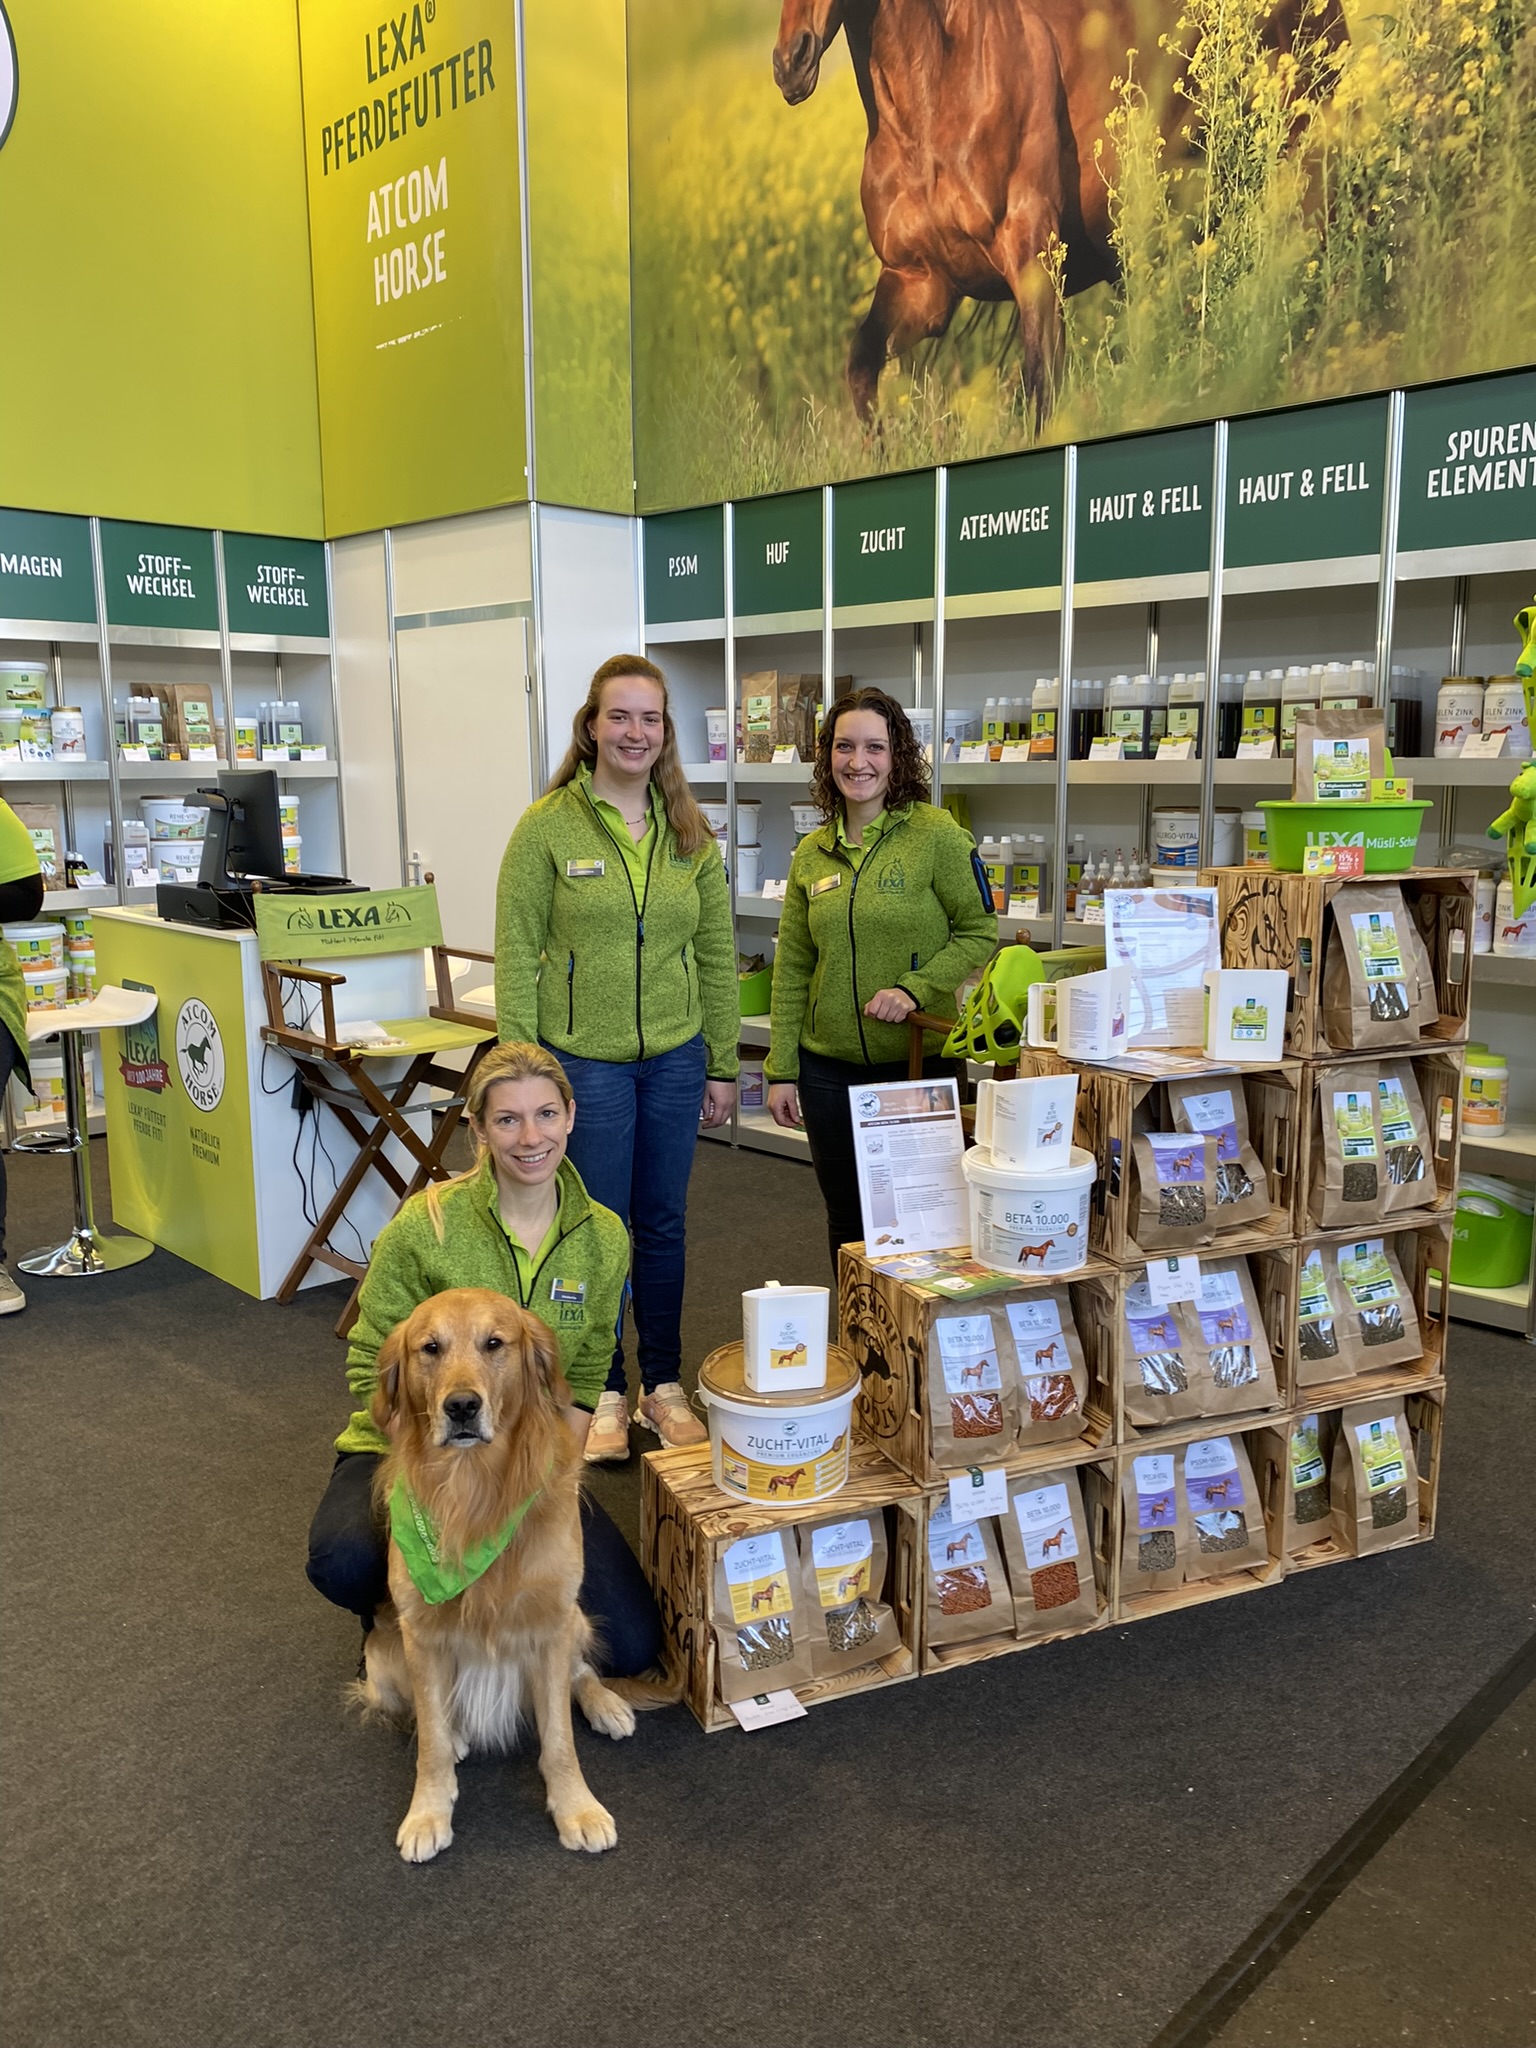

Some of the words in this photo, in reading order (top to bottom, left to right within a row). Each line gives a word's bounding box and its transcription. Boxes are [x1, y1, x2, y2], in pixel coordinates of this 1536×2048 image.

[322, 39, 496, 176] PFERDEFUTTER
[367, 156, 449, 243] ATCOM
[374, 229, 447, 306] HORSE
[1239, 472, 1294, 505] HAUT
[1299, 469, 1315, 497] &
[1321, 462, 1370, 494] FELL
[1089, 493, 1137, 523] HAUT
[1141, 491, 1156, 517] &
[1161, 484, 1203, 514] FELL
[959, 505, 1050, 540] ATEMWEGE
[859, 526, 906, 554] ZUCHT
[1, 553, 63, 578] MAGEN
[138, 554, 192, 576] STOFF-
[668, 554, 698, 577] PSSM
[766, 541, 790, 565] HUF
[127, 574, 196, 599] WECHSEL
[257, 564, 305, 584] STOFF-
[246, 584, 309, 607] WECHSEL
[317, 906, 381, 930] LEXA
[181, 1004, 217, 1039] ATCOM
[129, 1040, 157, 1065] LEXA
[185, 1073, 219, 1106] HORSE
[1005, 1213, 1033, 1225] BETA
[1036, 1212, 1070, 1225] 10.000
[747, 1433, 829, 1450] ZUCHT-VITAL
